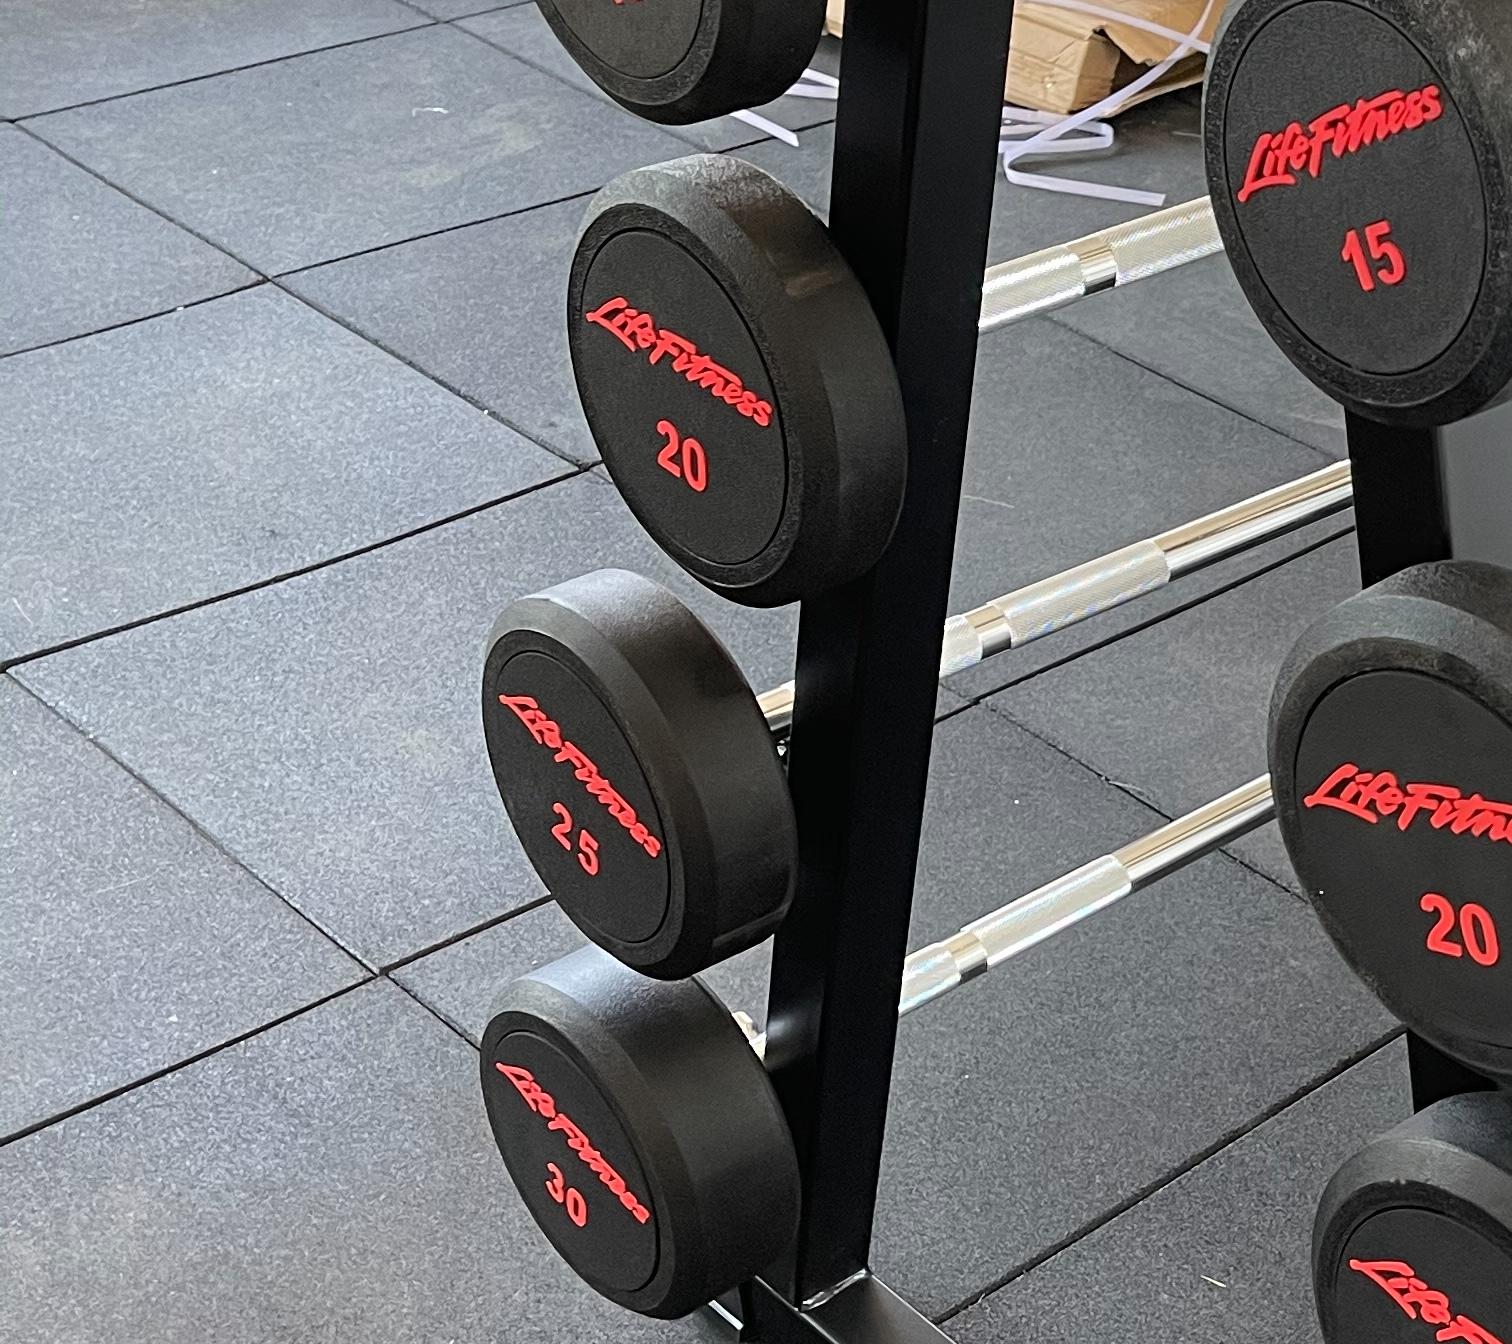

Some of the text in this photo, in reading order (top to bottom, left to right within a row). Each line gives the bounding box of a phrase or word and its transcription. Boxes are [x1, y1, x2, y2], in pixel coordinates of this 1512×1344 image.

[1339, 218, 1408, 293] 15
[655, 418, 710, 493] 20
[550, 801, 601, 877] 25
[1418, 891, 1502, 968] 20
[545, 1162, 589, 1228] 30
